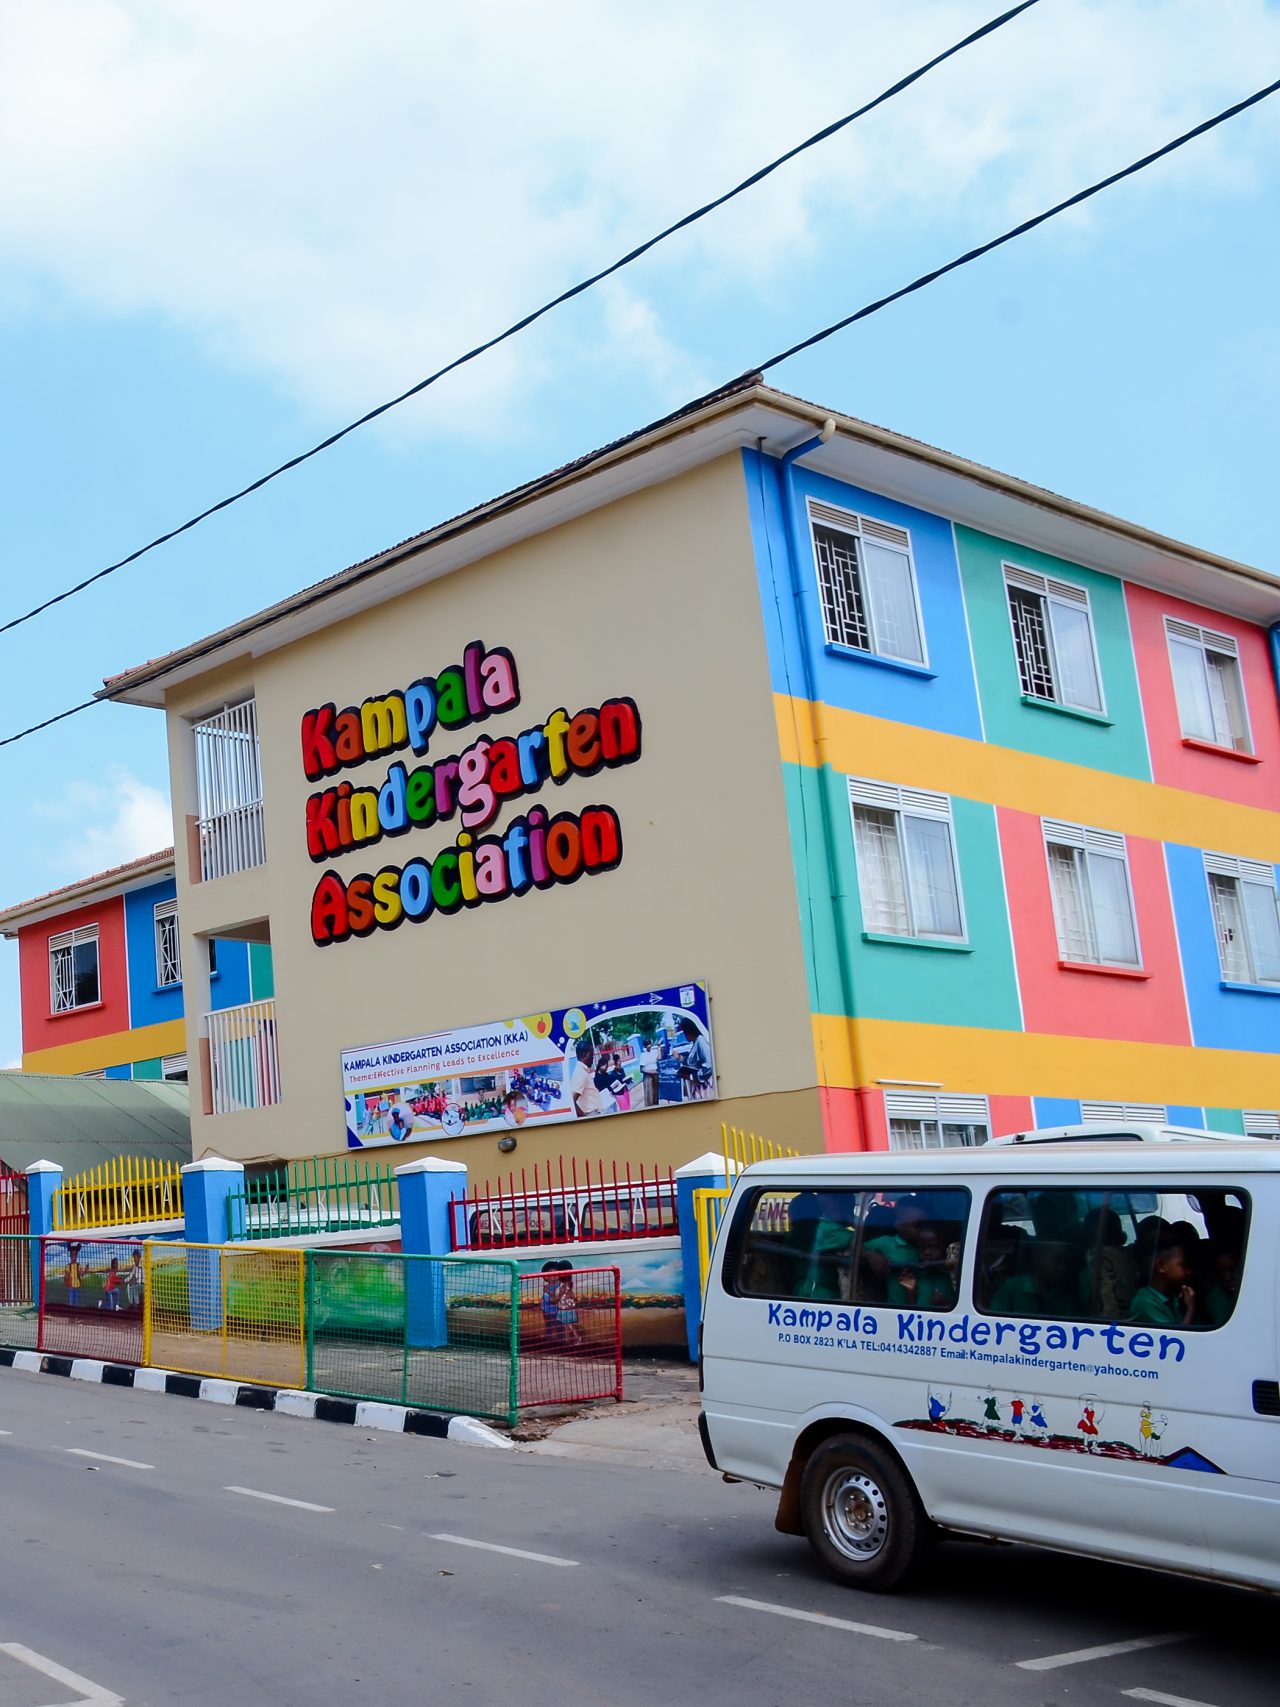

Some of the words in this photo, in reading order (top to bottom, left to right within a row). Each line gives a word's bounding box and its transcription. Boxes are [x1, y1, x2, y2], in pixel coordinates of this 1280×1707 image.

[301, 639, 521, 783] Kampala
[306, 696, 642, 863] Kindergarten
[310, 804, 623, 947] Association
[344, 1057, 381, 1072] KAMPALA
[382, 1046, 442, 1065] KINDERGARTEN
[445, 1035, 502, 1054] ASSOCIATION
[504, 1030, 528, 1046] (KKA)
[407, 1061, 441, 1073] Planning
[443, 1057, 465, 1067] Leads
[467, 1056, 476, 1064] to
[478, 1049, 520, 1062] Excellence
[768, 1303, 878, 1335] Kampala
[897, 1313, 1186, 1363] Kindergarten
[778, 1333, 791, 1343] P.O
[794, 1335, 811, 1345] BOX
[813, 1337, 834, 1347] 2823
[837, 1339, 858, 1350] K'LA
